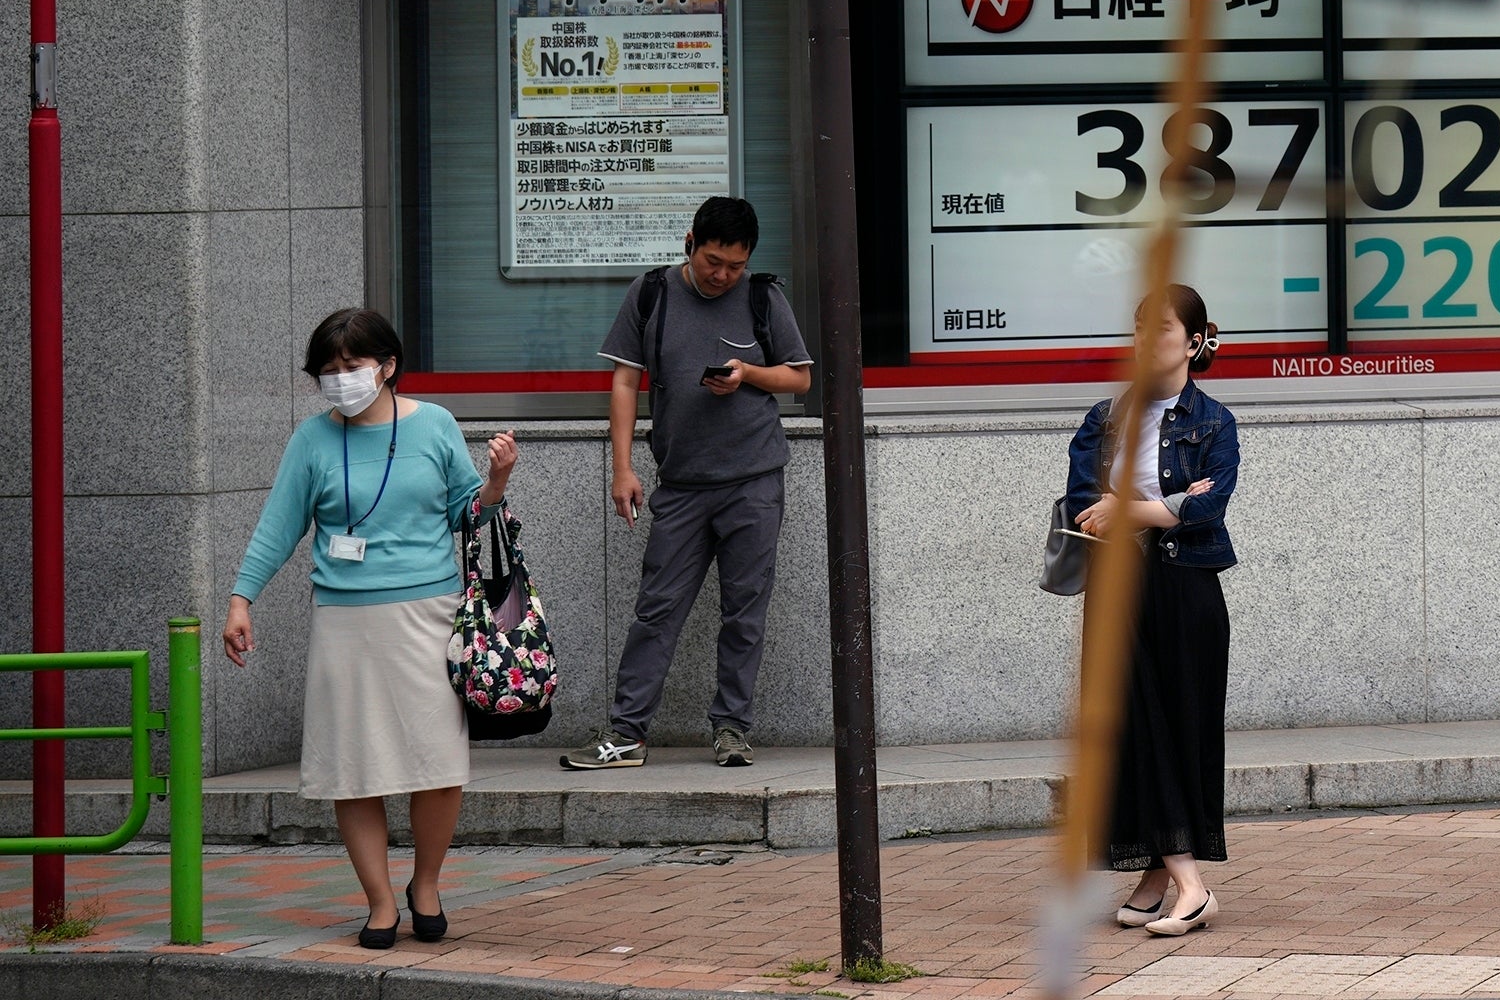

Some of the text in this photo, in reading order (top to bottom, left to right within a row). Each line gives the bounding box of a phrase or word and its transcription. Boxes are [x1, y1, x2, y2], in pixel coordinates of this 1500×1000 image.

[551, 21, 588, 35] 中国株
[539, 35, 599, 49] 取扱銘柄数
[516, 119, 667, 137] 少額資金からはじめられます
[516, 157, 656, 174] 取引時間中の注文が可能
[517, 177, 605, 193] 分別管理で安心
[518, 196, 614, 212] ノウハウと人材力
[941, 192, 1006, 215] 現在値
[943, 309, 1007, 331] 前日比
[1272, 355, 1435, 377] NAITO Securities
